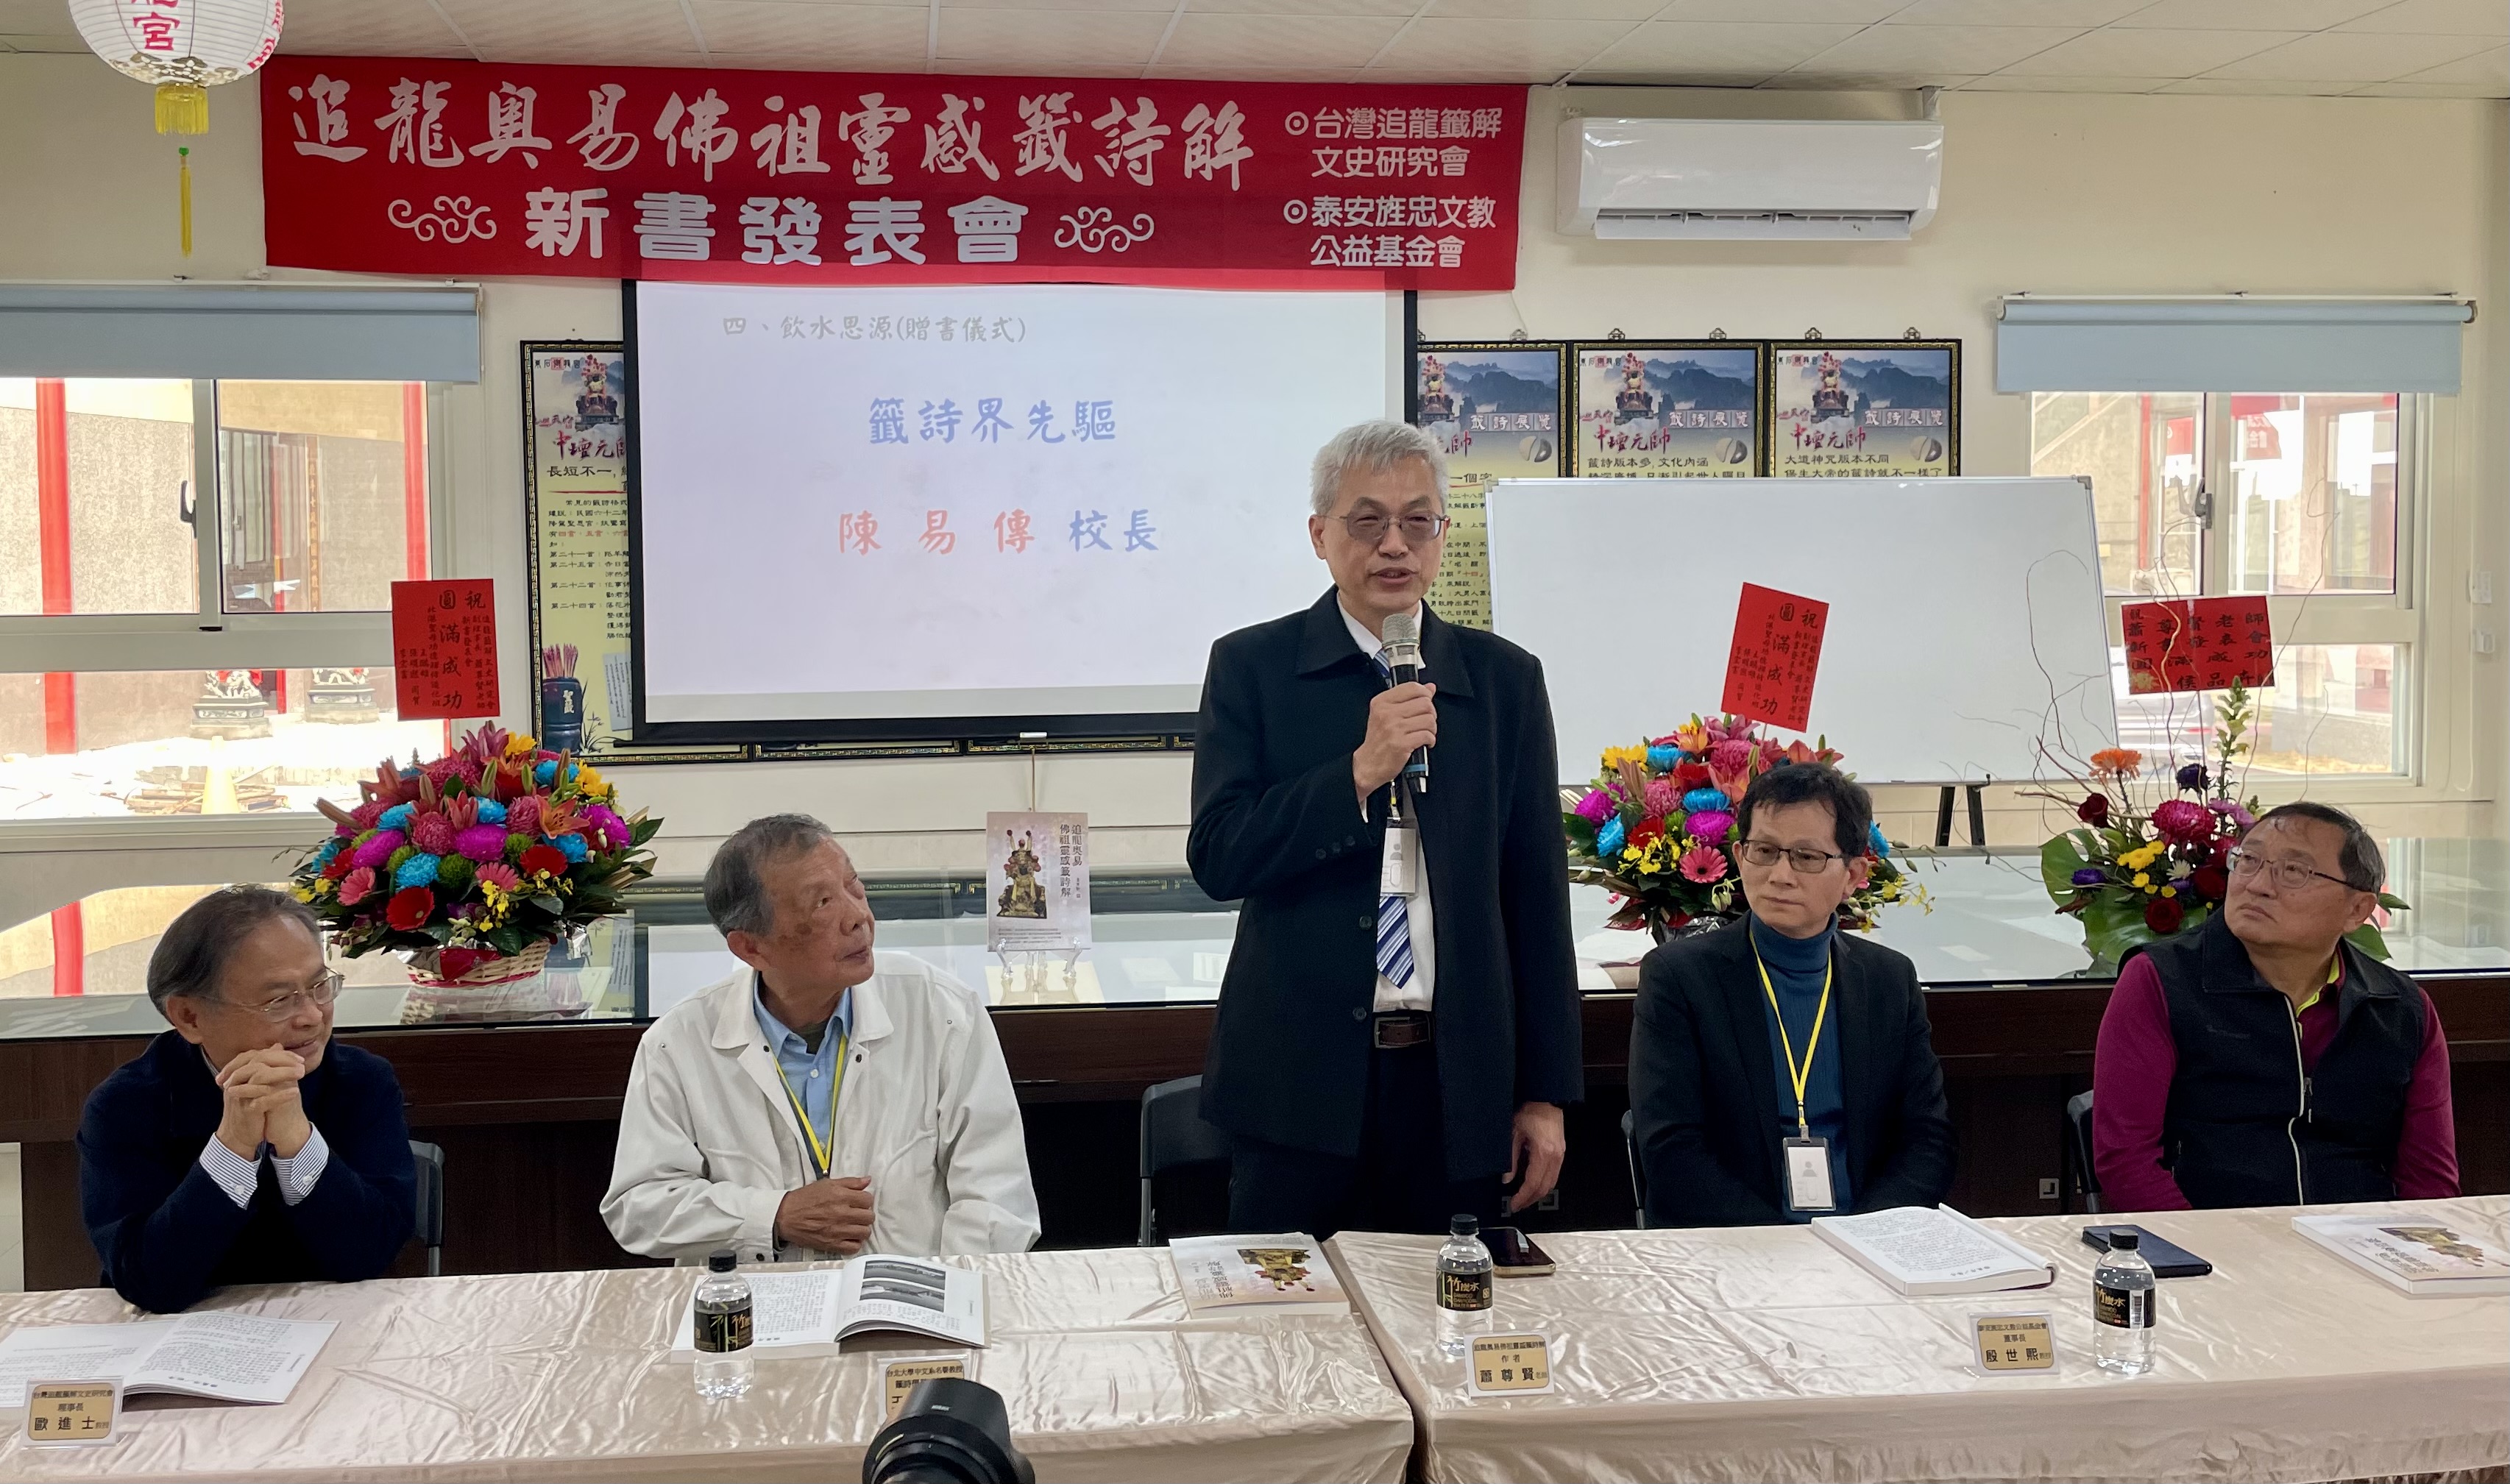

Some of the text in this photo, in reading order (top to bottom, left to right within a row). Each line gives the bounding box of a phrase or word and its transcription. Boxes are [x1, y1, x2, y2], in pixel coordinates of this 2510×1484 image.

[131, 0, 181, 52] 宮
[1313, 106, 1503, 141] 台灣追龍籤解
[1311, 143, 1471, 179] 文史研究會
[525, 186, 1029, 266] 新書發表會
[1310, 194, 1497, 230] 泰安旌忠文教
[1310, 233, 1466, 269] 公益基金會
[722, 313, 1027, 344] 四、飲水思源(贈書儀式)
[869, 397, 1117, 444] 籤詩界先驅
[1470, 413, 1552, 431] 籤詩展覽
[1668, 411, 1749, 428] 籤詩展覽
[1864, 409, 1943, 426] 籤詩展覽
[1593, 424, 1671, 455] 中壇元帥
[1790, 422, 1867, 452] 中壇元帥
[439, 589, 463, 710] 圓滿成功
[1759, 602, 1795, 716] 圓滿成功
